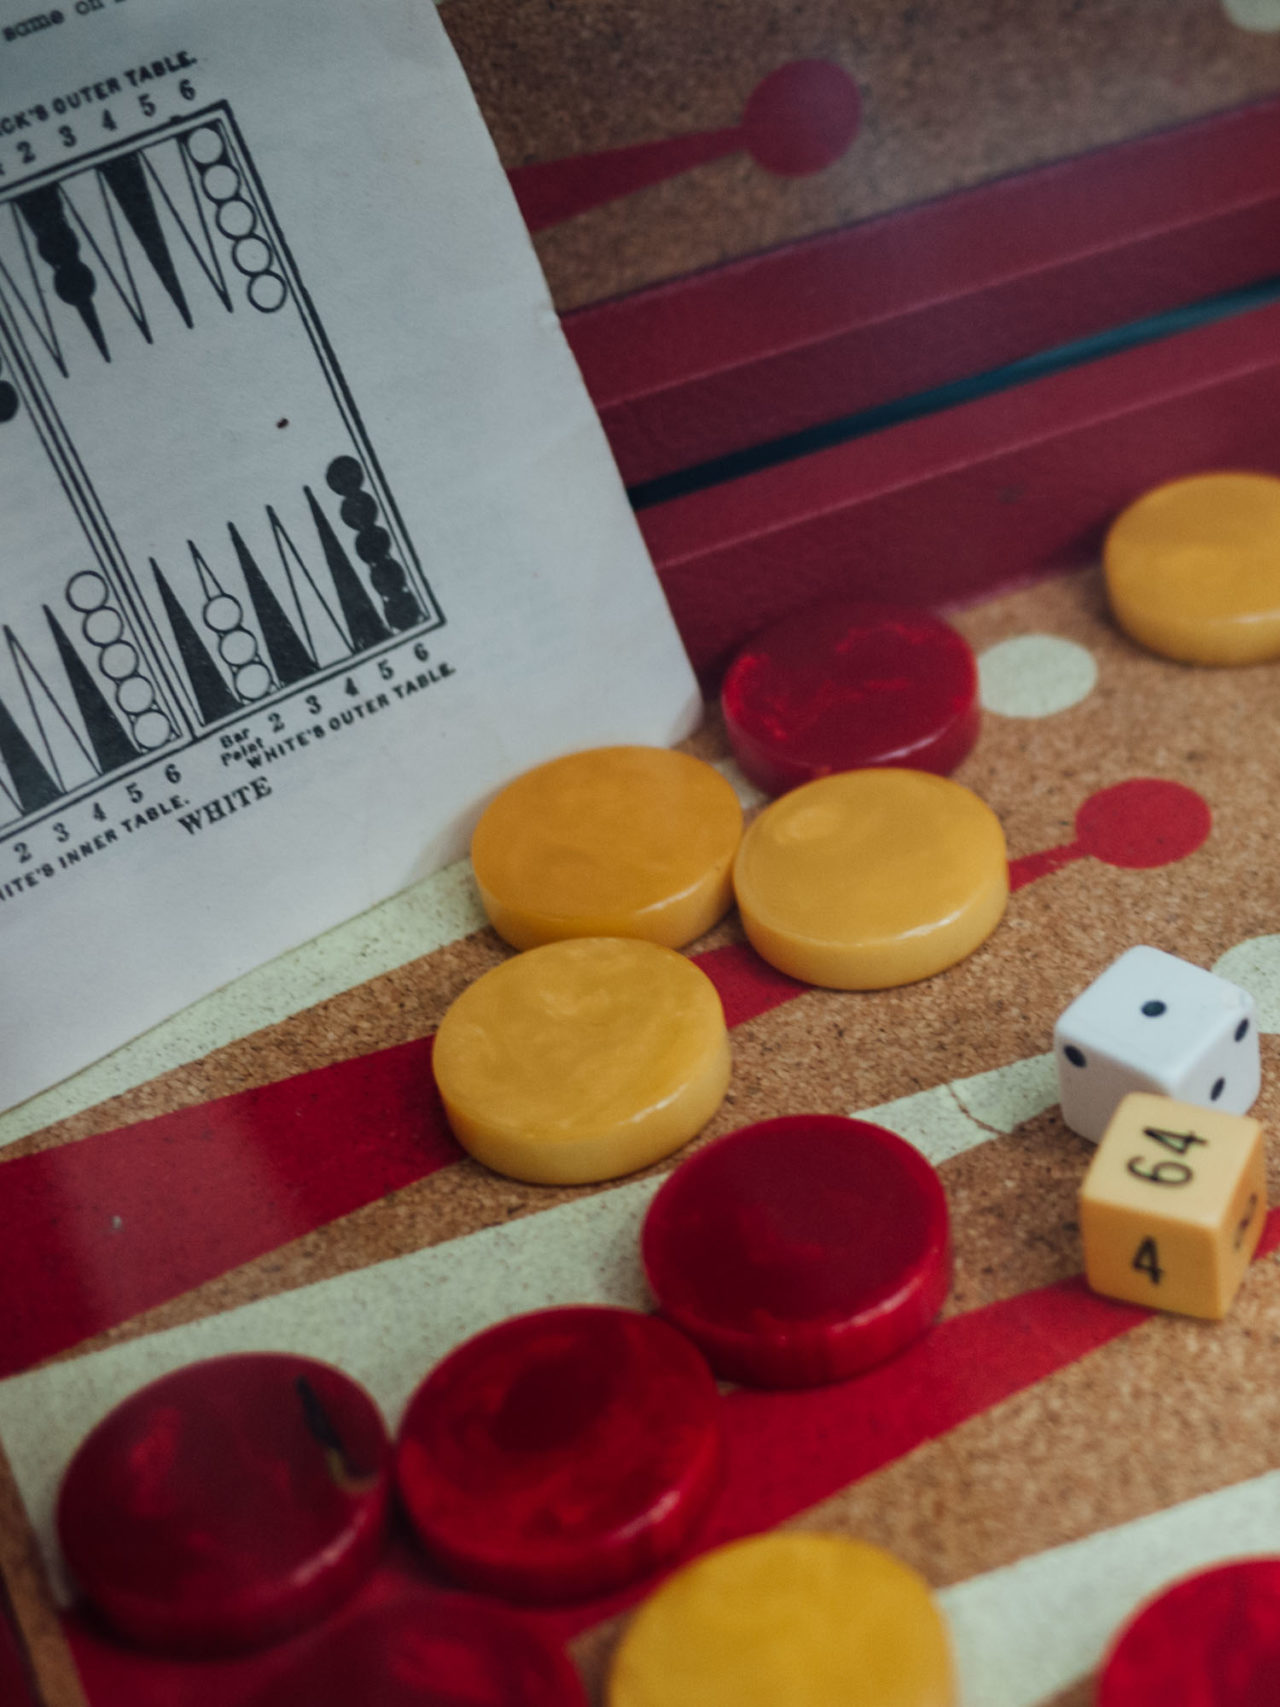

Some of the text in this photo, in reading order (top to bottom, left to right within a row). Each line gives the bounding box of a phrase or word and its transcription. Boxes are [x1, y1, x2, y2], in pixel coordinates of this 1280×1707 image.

[0, 104, 50, 136] CK'S
[52, 77, 122, 114] OUTER
[16, 79, 196, 164] 2 3 4 5 6
[268, 641, 430, 733] 2 3 4 5 6
[220, 728, 249, 748] Bar
[220, 737, 264, 767] Point
[246, 725, 325, 769] WHITE'S
[328, 692, 390, 732] OUTER
[13, 764, 182, 863] 2 3 4 5 6
[58, 829, 118, 869] INNER
[121, 794, 191, 834] TABLE.
[177, 776, 273, 836] WHITE
[1126, 1126, 1208, 1187] 64
[1132, 1235, 1164, 1284] 4
